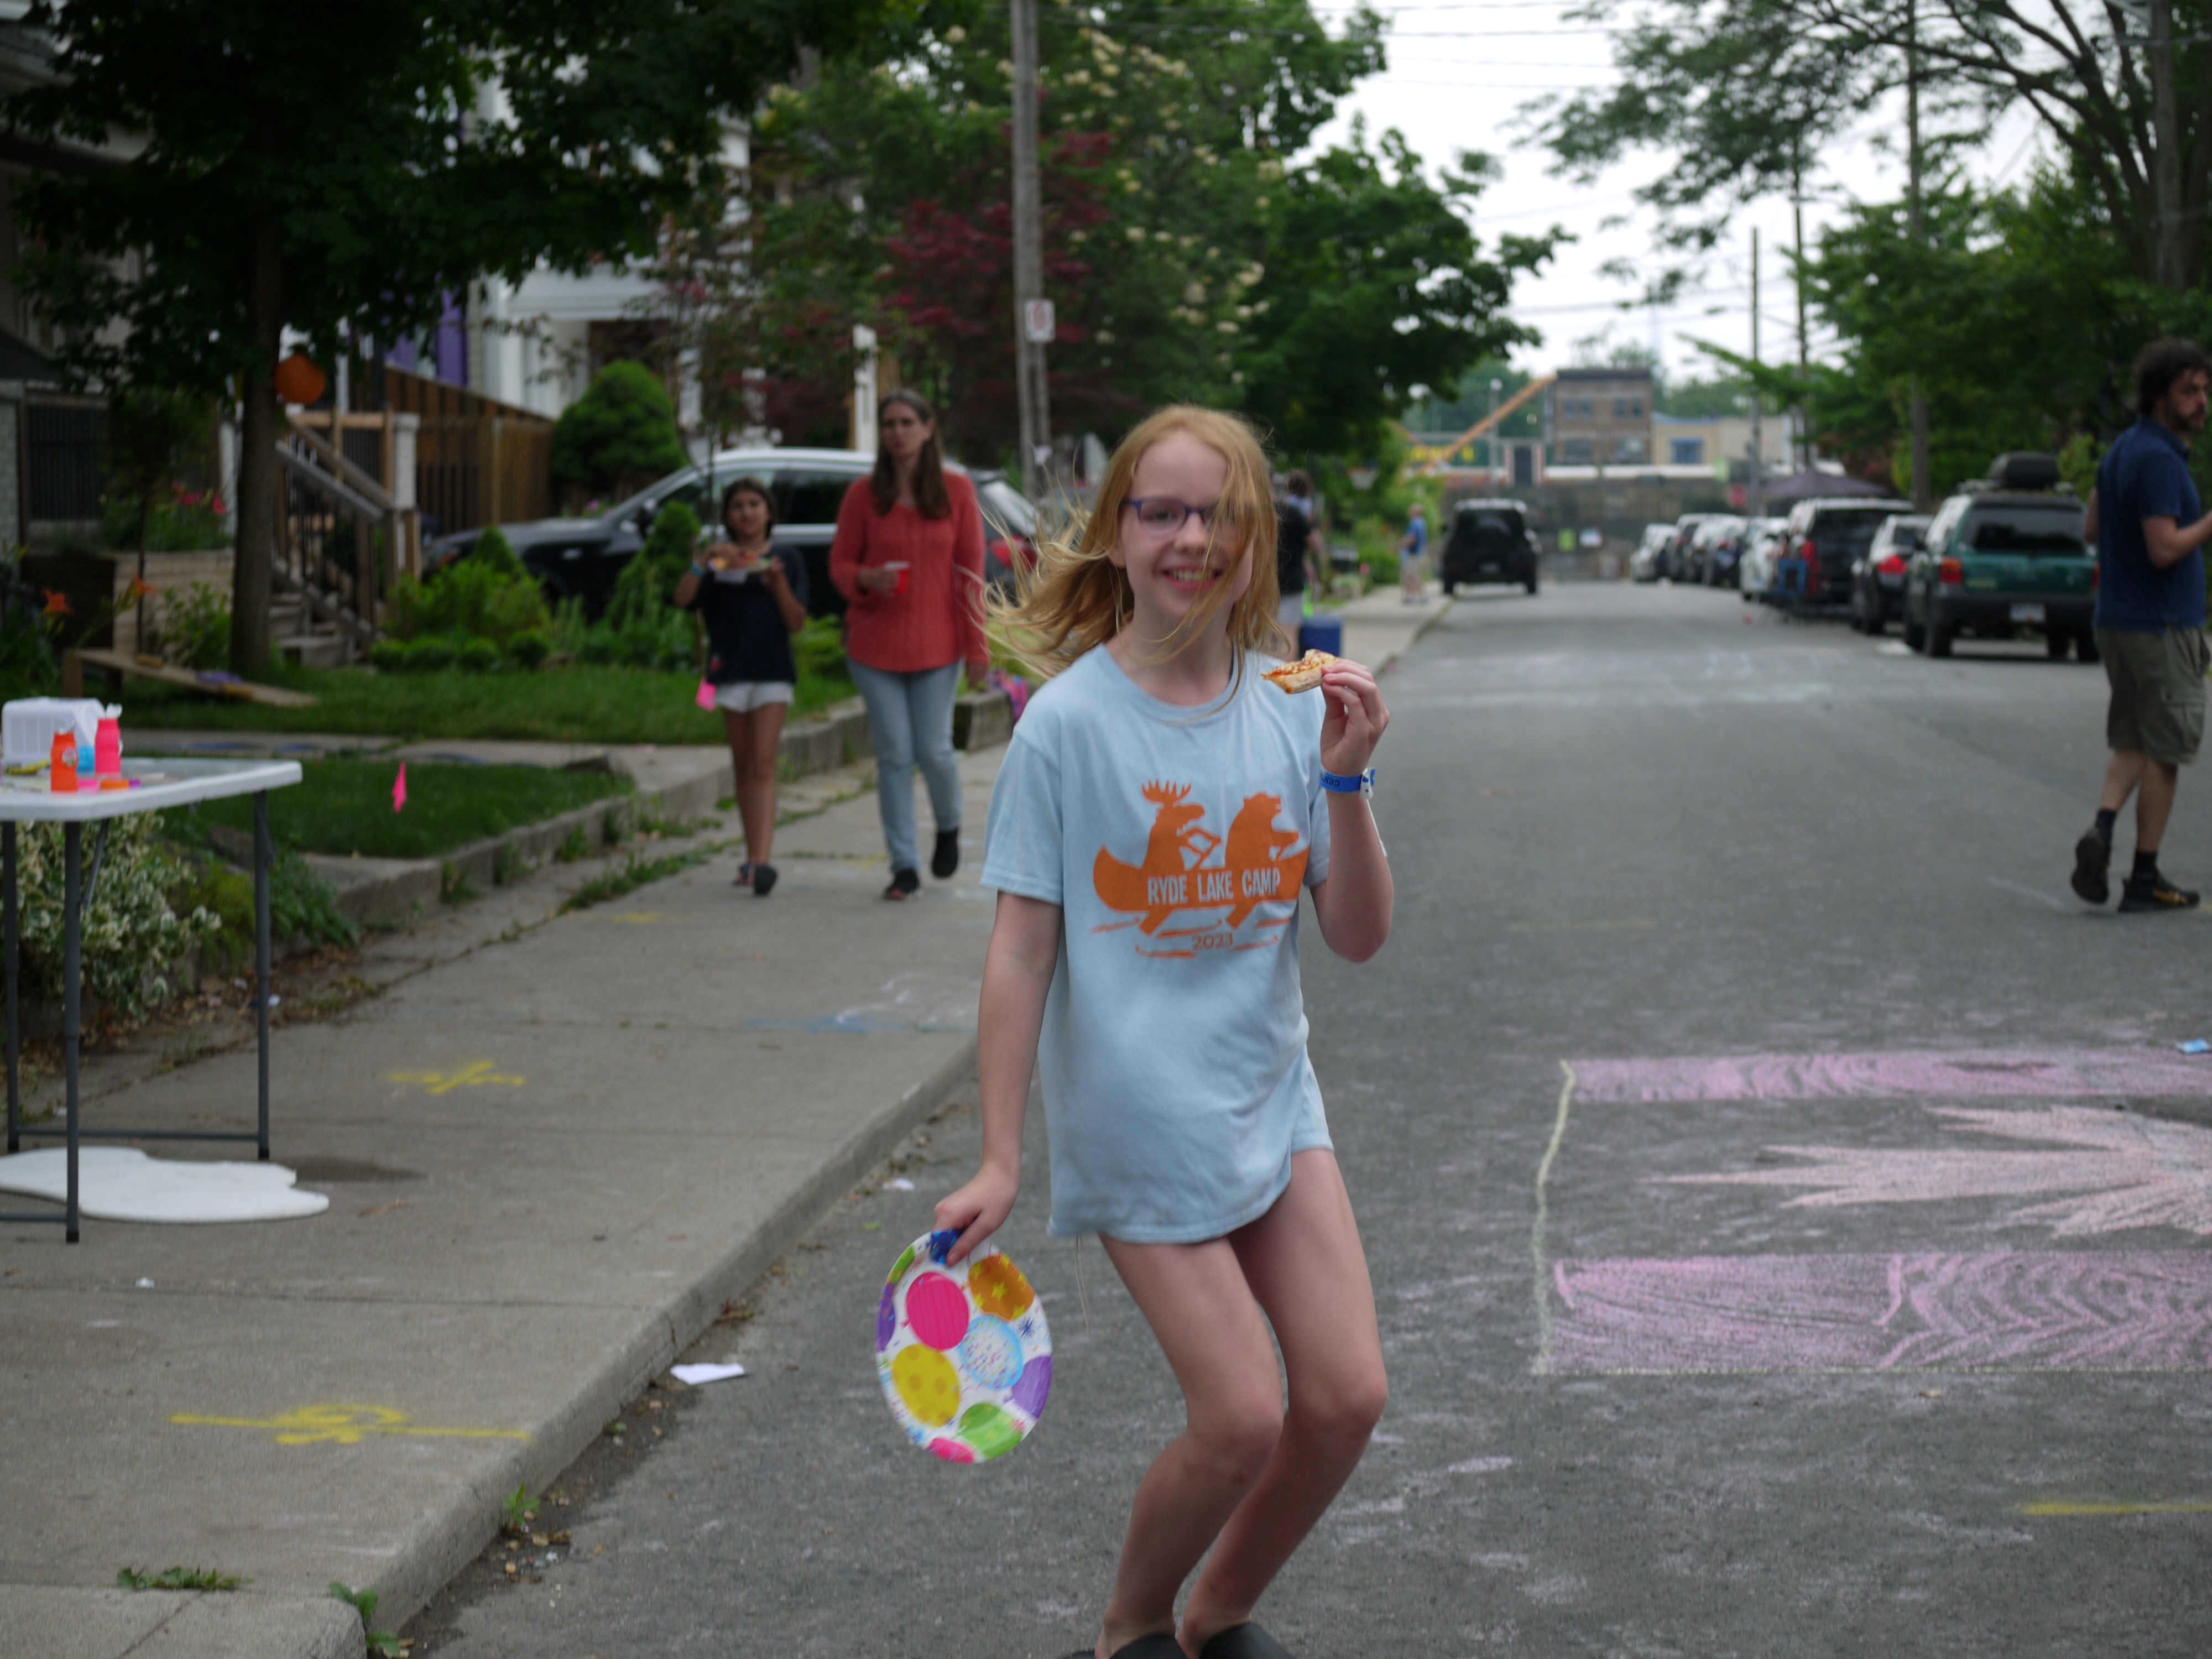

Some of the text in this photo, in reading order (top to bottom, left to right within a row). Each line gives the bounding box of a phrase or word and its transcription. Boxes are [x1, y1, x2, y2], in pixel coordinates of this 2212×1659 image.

[1147, 868, 1281, 905] RYDE LAKE CAMP
[1193, 932, 1233, 950] 2023
